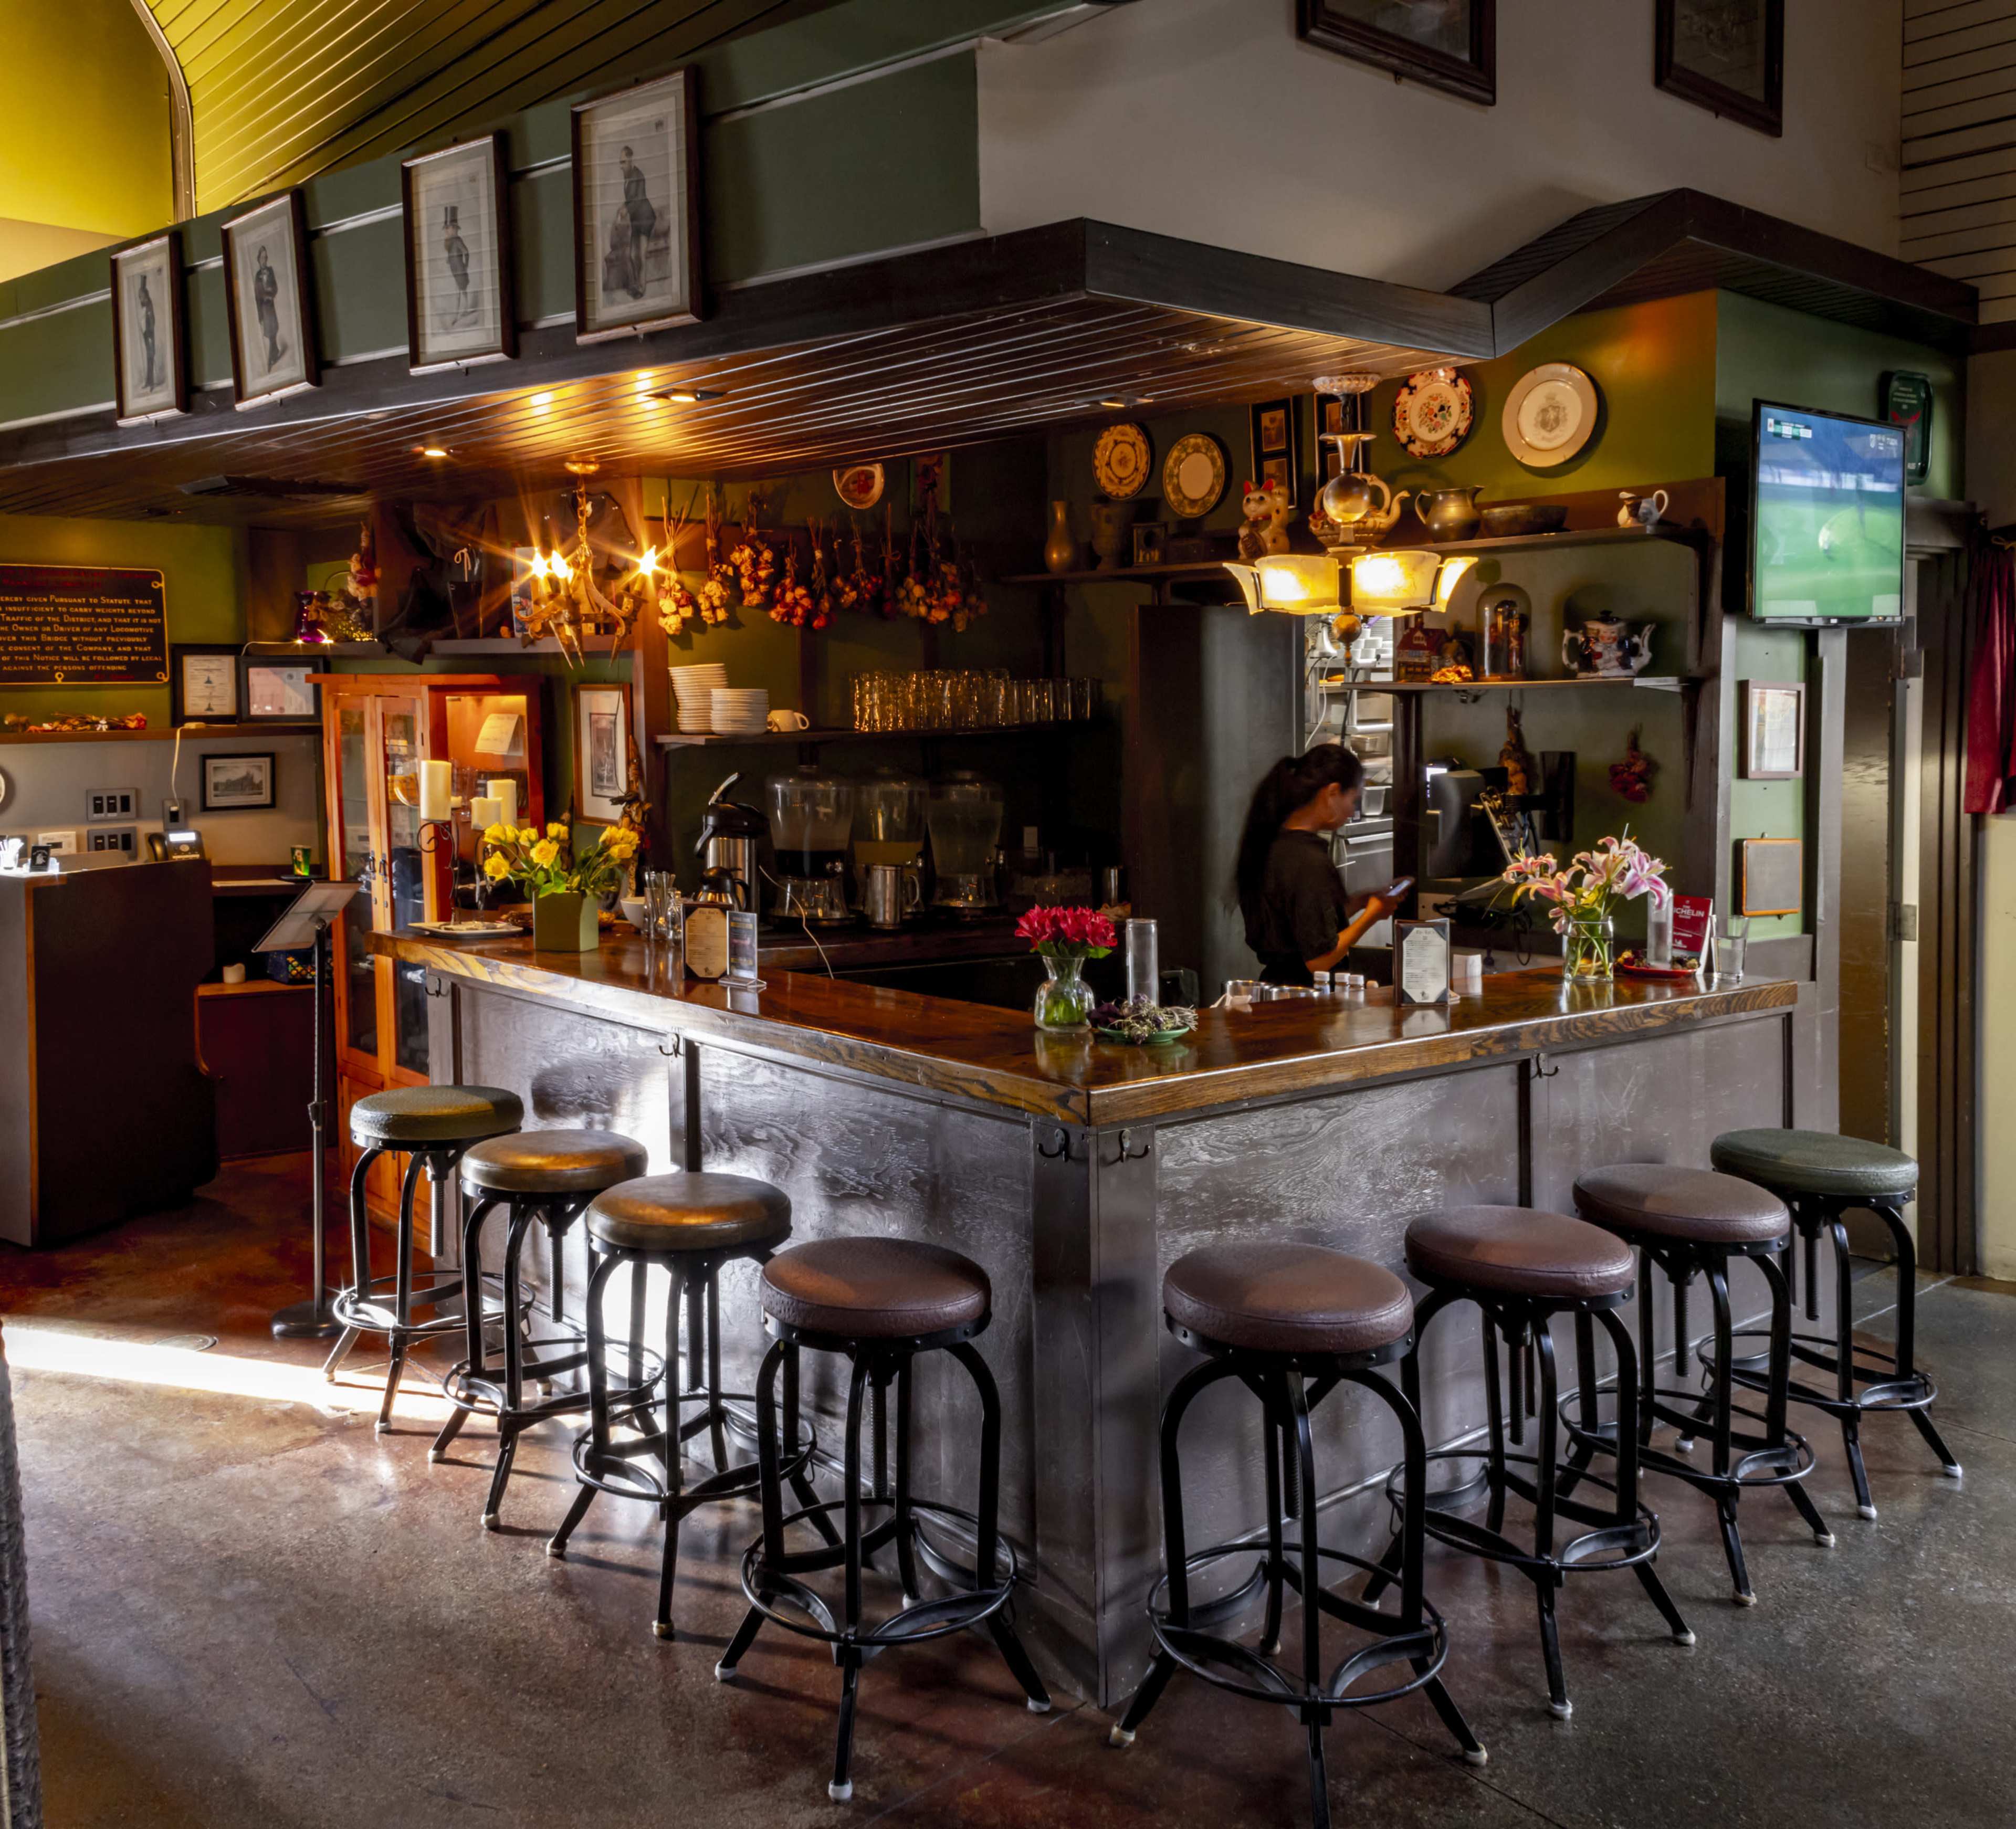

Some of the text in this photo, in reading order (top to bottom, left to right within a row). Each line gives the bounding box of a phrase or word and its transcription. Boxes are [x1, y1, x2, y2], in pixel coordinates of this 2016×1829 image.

[50, 594, 86, 603] PURSUANT
[0, 613, 32, 622] TRAFFIC
[111, 624, 154, 633] LOCOMOTIVE
[1673, 907, 1705, 918] ICHELIN
